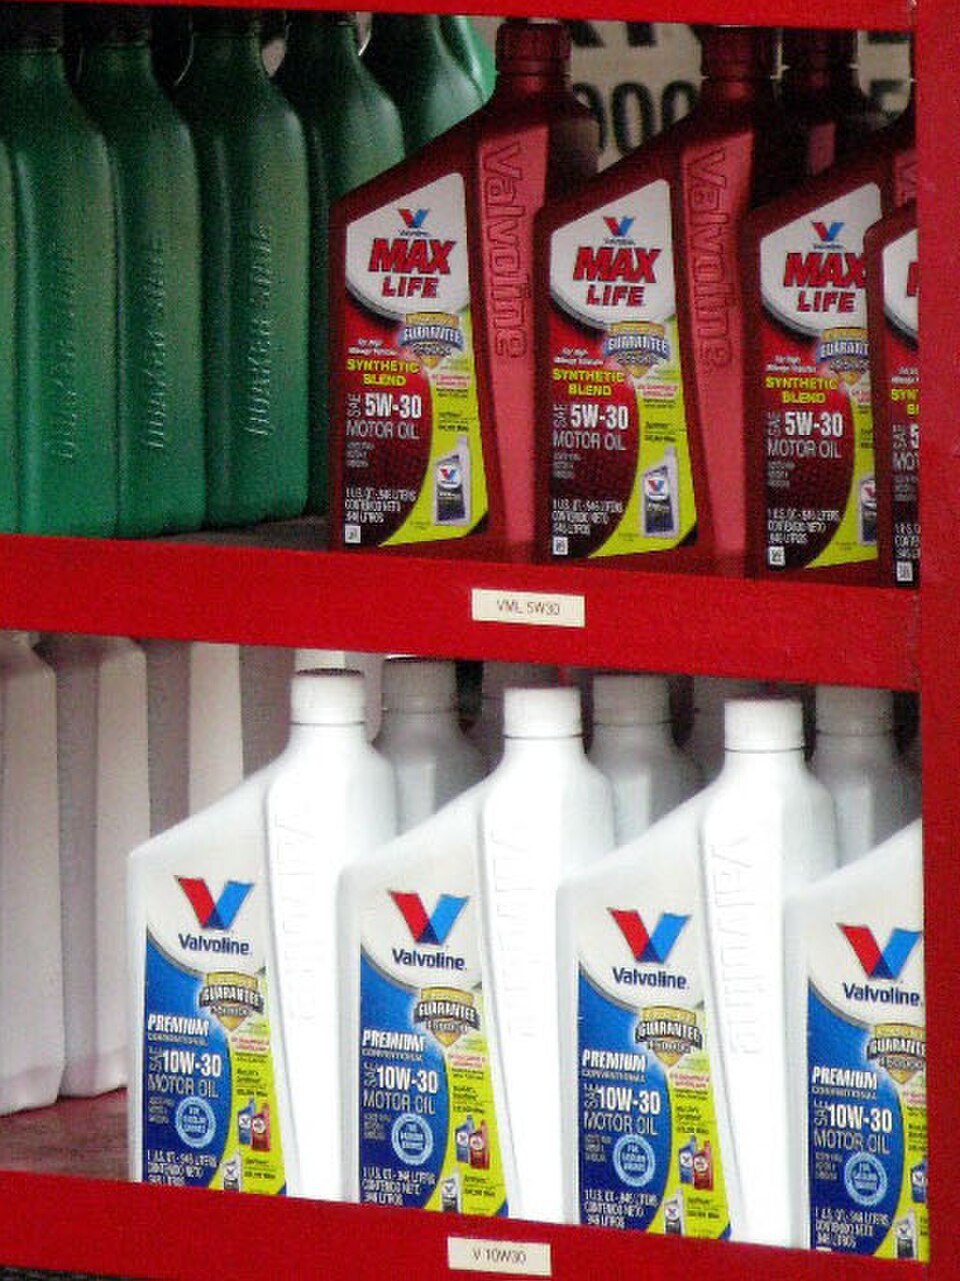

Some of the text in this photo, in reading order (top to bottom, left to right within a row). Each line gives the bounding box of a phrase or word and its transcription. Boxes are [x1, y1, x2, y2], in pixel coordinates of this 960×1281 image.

[368, 238, 456, 275] MAX
[483, 141, 532, 358] Valvoline
[573, 247, 662, 283] MAX
[783, 253, 867, 288] MAX
[382, 276, 439, 298] LIFE
[586, 285, 645, 307] LIFE
[797, 291, 856, 312] LIFE
[347, 358, 420, 373] SYNTHETIC
[553, 368, 625, 383] SYNTHETIC
[363, 374, 407, 386] BLEND
[568, 385, 612, 396] BLEND
[766, 376, 838, 390] SYNTHETIC
[365, 394, 422, 418] 5W-30
[782, 392, 826, 404] BLEND
[571, 404, 629, 430] 5W-30
[784, 411, 844, 437] 5W-30
[178, 933, 250, 955] Valvoline
[392, 948, 465, 970] Valvoline
[612, 967, 686, 989] Valvoline
[843, 982, 920, 1006] Valvoline
[148, 1014, 209, 1036] PREMIUM
[362, 1030, 425, 1052] PREMIUM
[163, 1049, 221, 1077] 10W-30
[582, 1050, 645, 1072] PREMIUM
[376, 1066, 438, 1094] 10W-30
[812, 1066, 877, 1089] PREMIUM
[362, 1090, 435, 1115] MOTOR OIL
[599, 1086, 661, 1115] 10W-30
[584, 1112, 658, 1135] MOTOR OIL
[828, 1104, 892, 1132] 10W-30
[814, 1130, 889, 1154] MOTOR OIL
